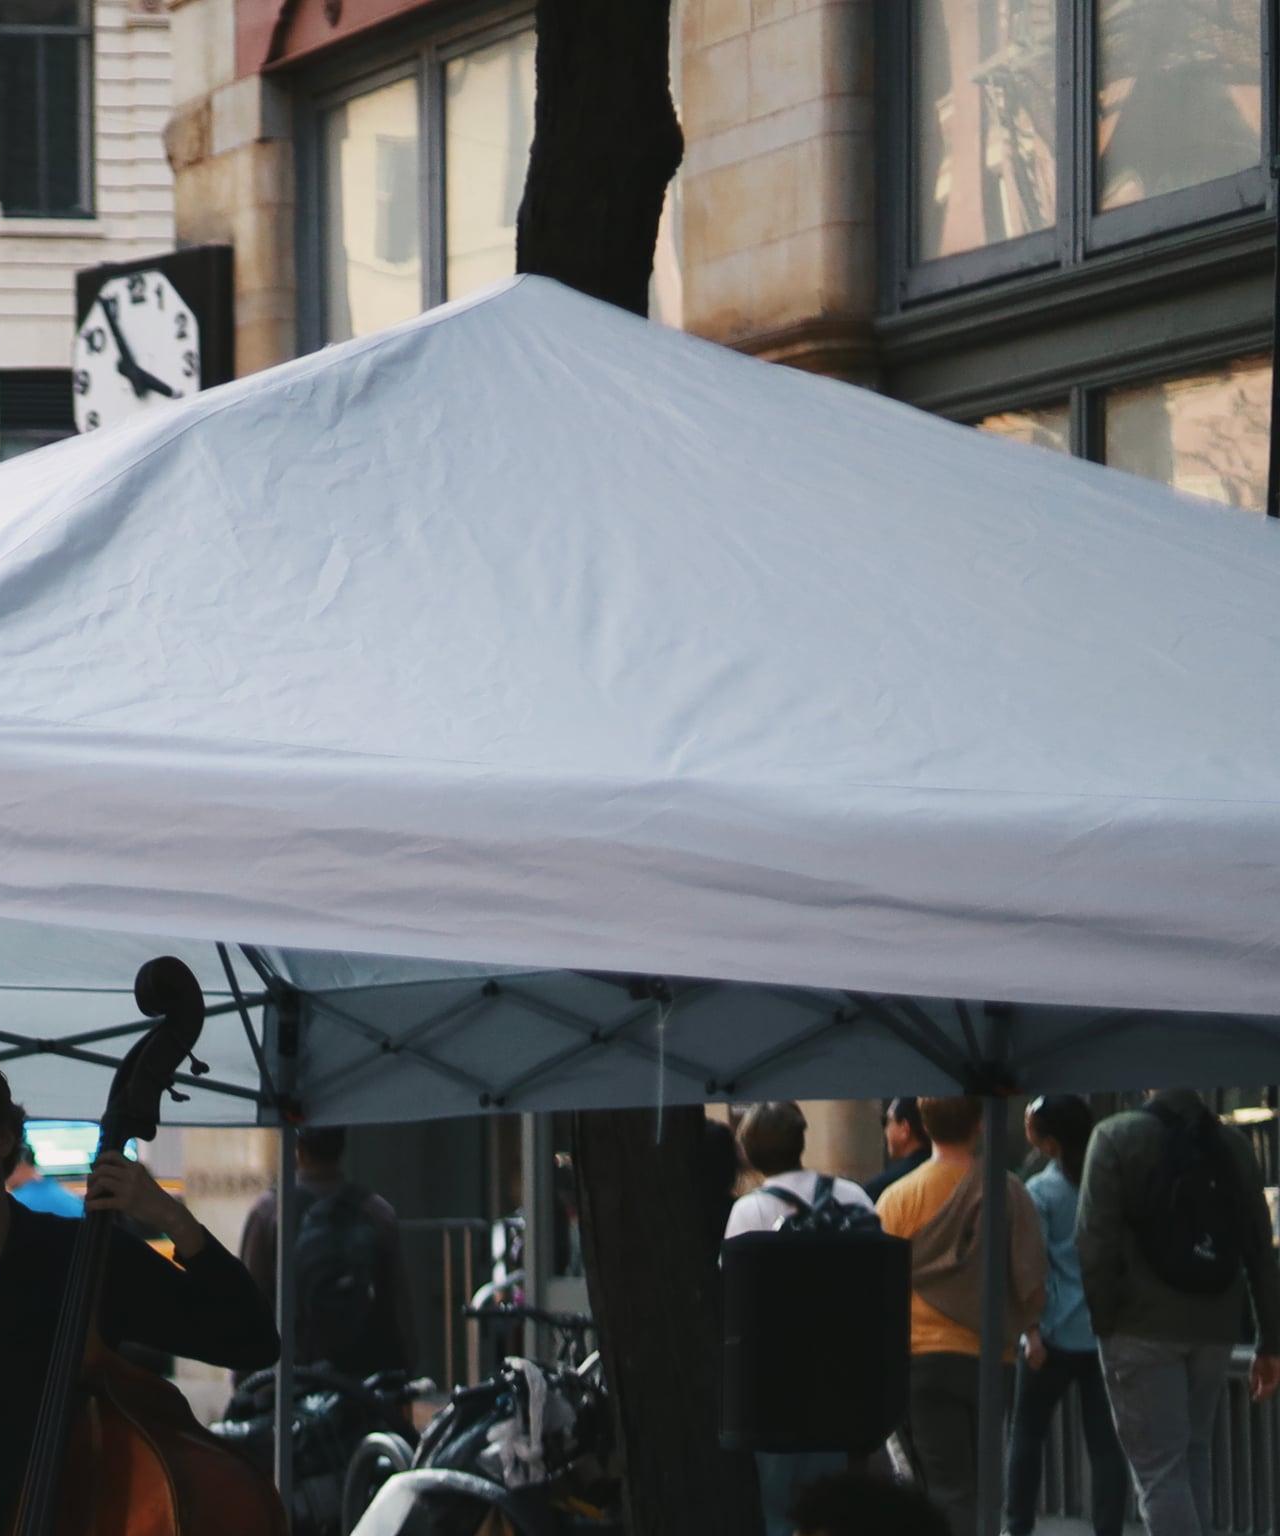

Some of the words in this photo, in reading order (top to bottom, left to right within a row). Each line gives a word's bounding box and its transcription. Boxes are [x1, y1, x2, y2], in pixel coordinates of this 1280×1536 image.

[128, 274, 146, 304] 12
[155, 283, 164, 310] 1
[175, 311, 187, 340] 2
[80, 326, 106, 354] 10
[183, 350, 199, 378] 3
[74, 370, 90, 395] 9
